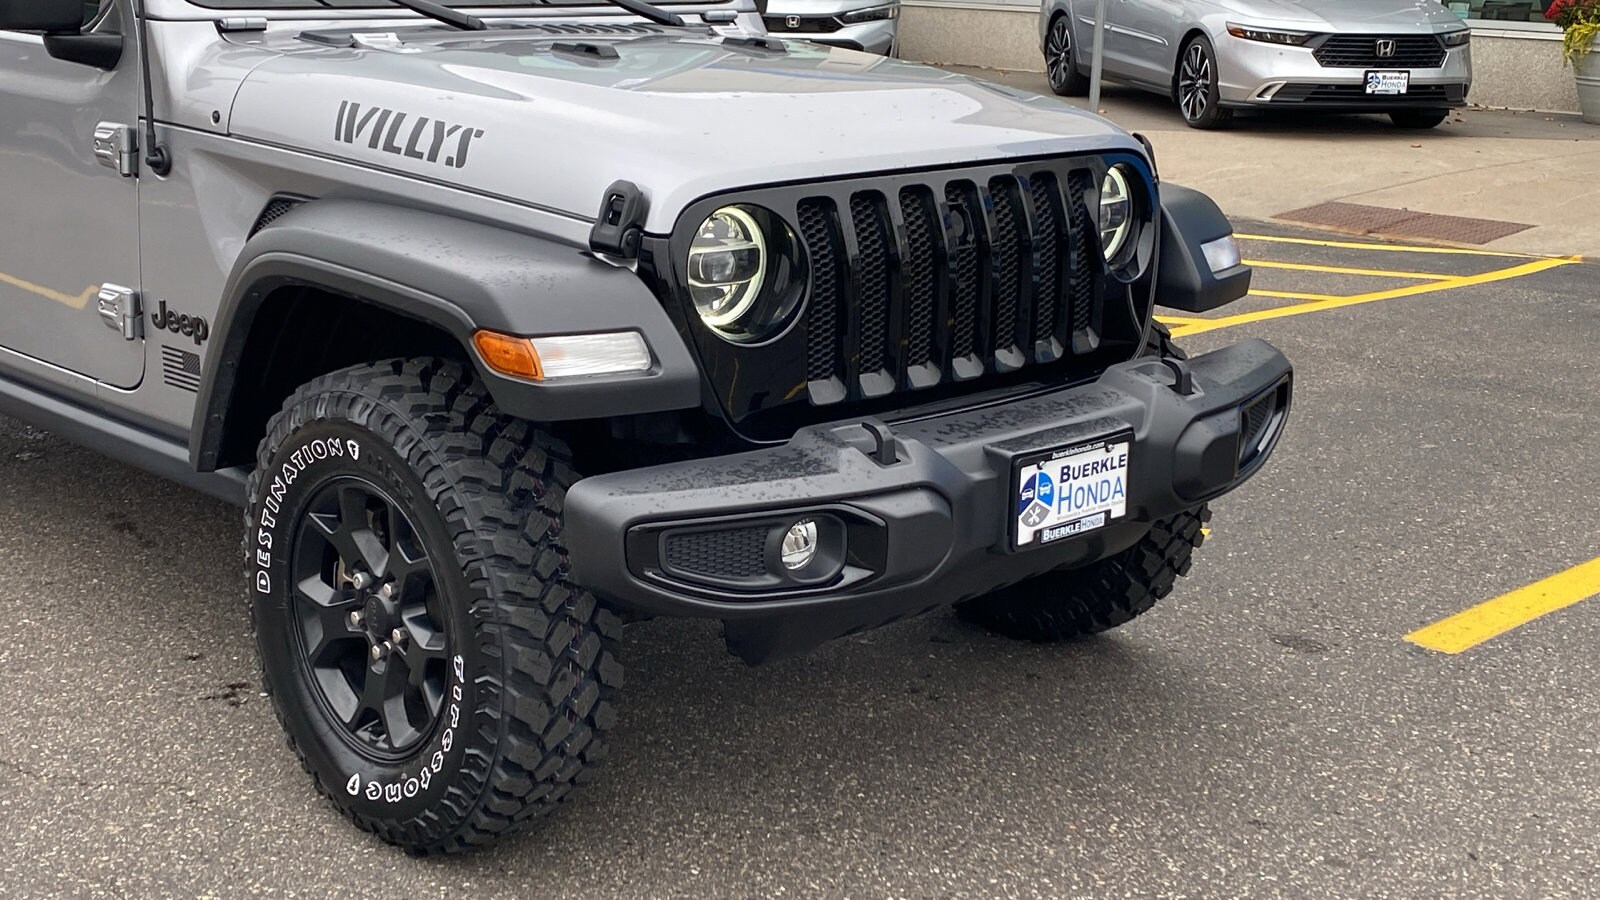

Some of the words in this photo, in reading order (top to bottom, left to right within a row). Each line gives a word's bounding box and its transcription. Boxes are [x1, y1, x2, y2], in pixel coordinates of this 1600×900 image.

[1381, 80, 1406, 89] HONDA
[335, 100, 484, 168] WILLYS
[151, 299, 209, 346] Jeep
[1060, 453, 1127, 483] BUERKLE
[1058, 475, 1125, 515] HONDA
[257, 437, 344, 594] DESTINATION
[1043, 522, 1081, 541] BUERKLE
[1081, 517, 1103, 530] HONDA
